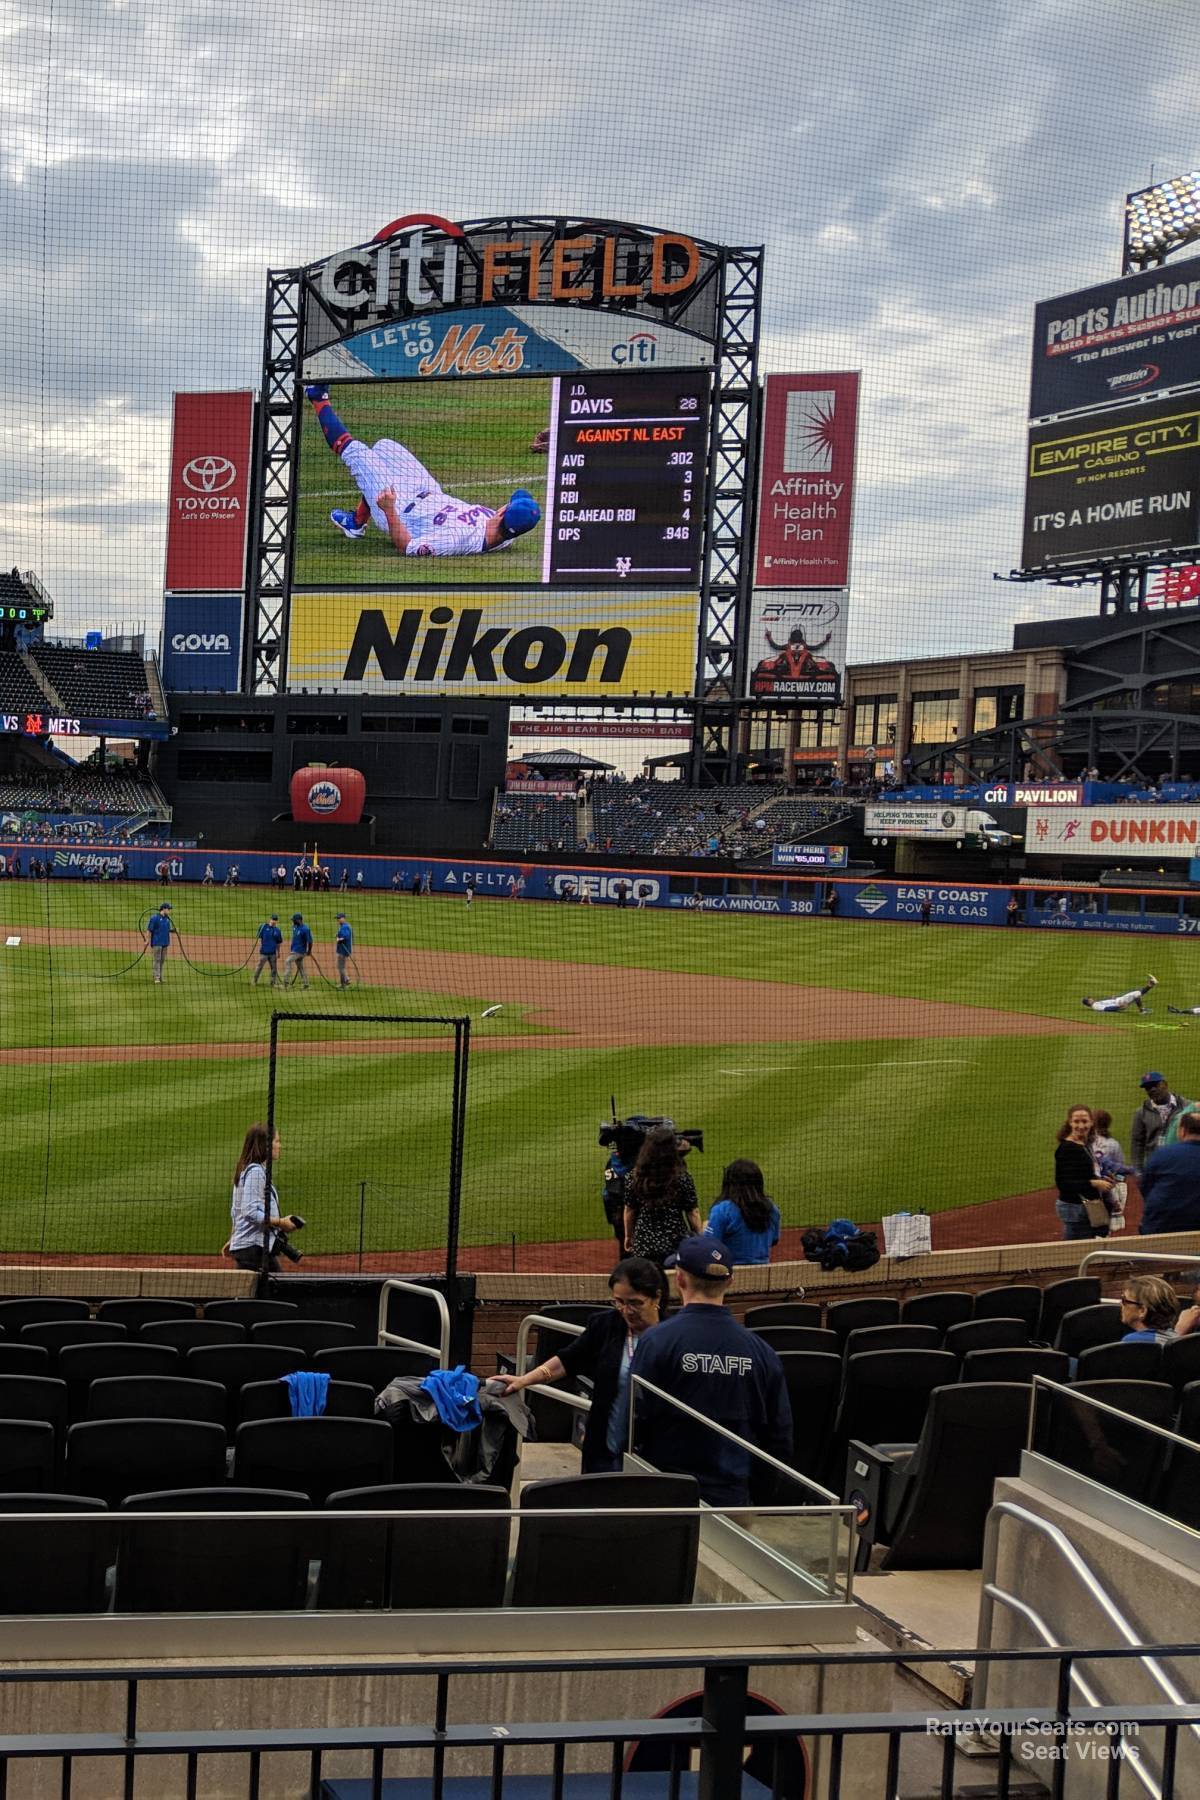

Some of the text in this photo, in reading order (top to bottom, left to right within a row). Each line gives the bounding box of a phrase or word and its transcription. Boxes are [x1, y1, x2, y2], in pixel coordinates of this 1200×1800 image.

[321, 230, 699, 307] citi FIELD
[1047, 306, 1109, 345] Parts
[1052, 315, 1174, 353] Auto Parts Super
[370, 320, 431, 349] LET'S
[404, 338, 433, 358] GO
[418, 324, 527, 375] Mets
[612, 338, 655, 363] citi
[1100, 338, 1149, 360] Answer
[1152, 334, 1165, 345] Is
[570, 385, 587, 396] J.D.
[570, 398, 698, 414] DAVIS 28
[576, 427, 686, 442] AGAINST NL EAST
[1039, 423, 1192, 466] EMPIRE CITY
[562, 452, 693, 467] AVG .302
[1084, 452, 1140, 469] CASINO
[561, 471, 692, 486] HR 3
[1076, 476, 1086, 485] BY
[1108, 465, 1147, 478] RESORTS
[560, 489, 692, 504] RBI 5
[770, 478, 845, 500] Affinity
[176, 497, 240, 510] TOYOTA
[773, 502, 837, 520] Health
[1033, 490, 1191, 533] IT'S A HOME RUN
[181, 512, 235, 520] Let's Go Places
[559, 508, 690, 522] GO-AHEAD RBI 4
[558, 527, 689, 541] OPS .946
[784, 524, 824, 541] Plan
[773, 558, 798, 567] Affinity
[823, 557, 839, 565] Plan
[171, 632, 230, 652] GOYA
[342, 606, 632, 685] Nikon
[3, 715, 18, 731] VS
[48, 718, 80, 734] METS
[518, 725, 540, 733] THE
[543, 725, 563, 733] JIM
[602, 726, 655, 735] BOURBON
[660, 727, 683, 735] BAR
[984, 788, 1078, 804] citi PAVILION
[1090, 819, 1197, 844] DUNKIN
[803, 846, 825, 854] HERE
[462, 871, 516, 886] DELTA
[553, 874, 660, 900] GEICO
[897, 888, 988, 903] EAST COAST
[729, 898, 813, 913] MINOLTA 380
[960, 905, 988, 918] GAS
[682, 1353, 752, 1376] STAFF
